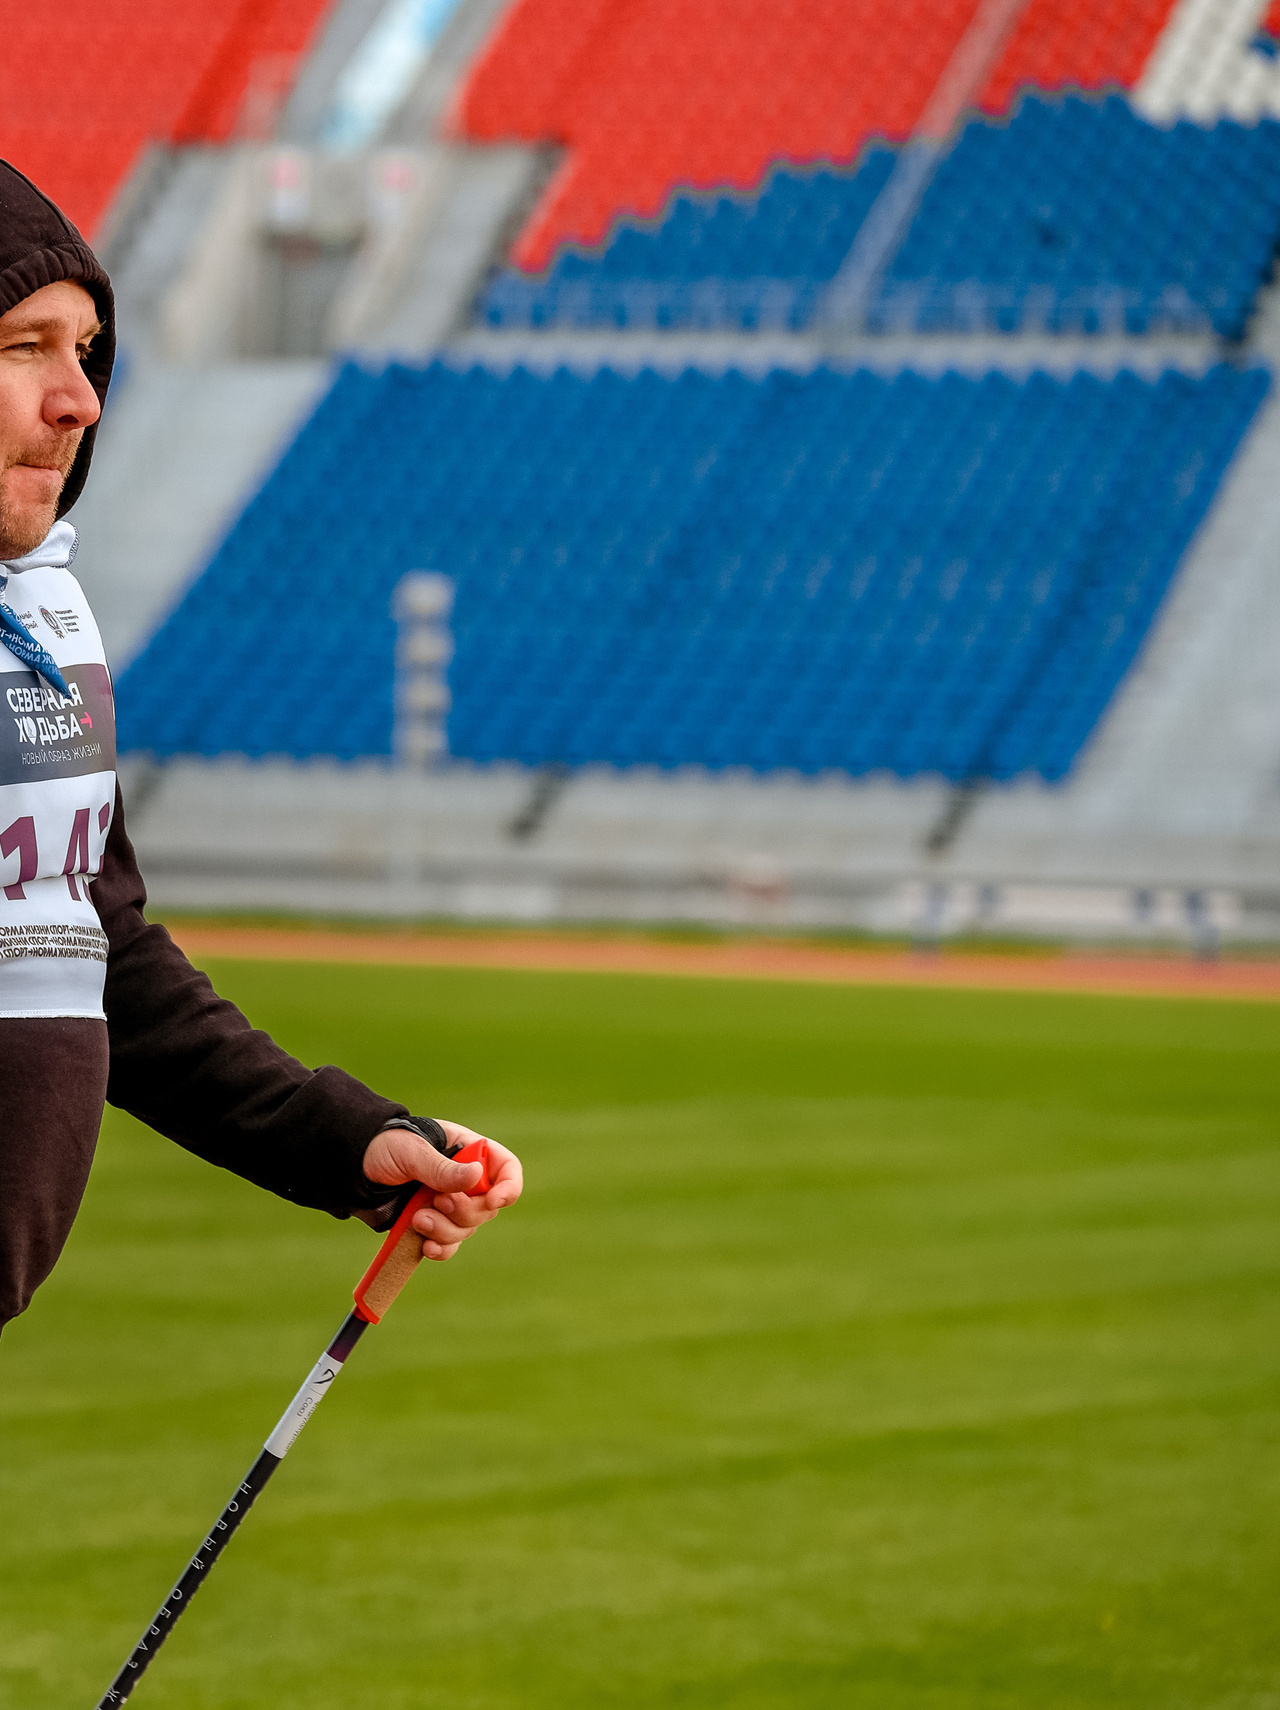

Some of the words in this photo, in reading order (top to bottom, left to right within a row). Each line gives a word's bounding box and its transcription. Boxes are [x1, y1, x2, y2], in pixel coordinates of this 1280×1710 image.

[14, 712, 84, 746] ХОДЬБА
[21, 749, 48, 765] НОВЫЙ
[48, 749, 72, 762] ОБРАЗ
[71, 743, 102, 760] ЖИЗНИ
[23, 925, 50, 935] ЖИЗНИ
[3, 946, 29, 958] СПОРТ
[32, 947, 58, 958] НОРМА
[190, 1480, 251, 1570] НОВЫЙ
[126, 1586, 184, 1669] ОБРАЗ
